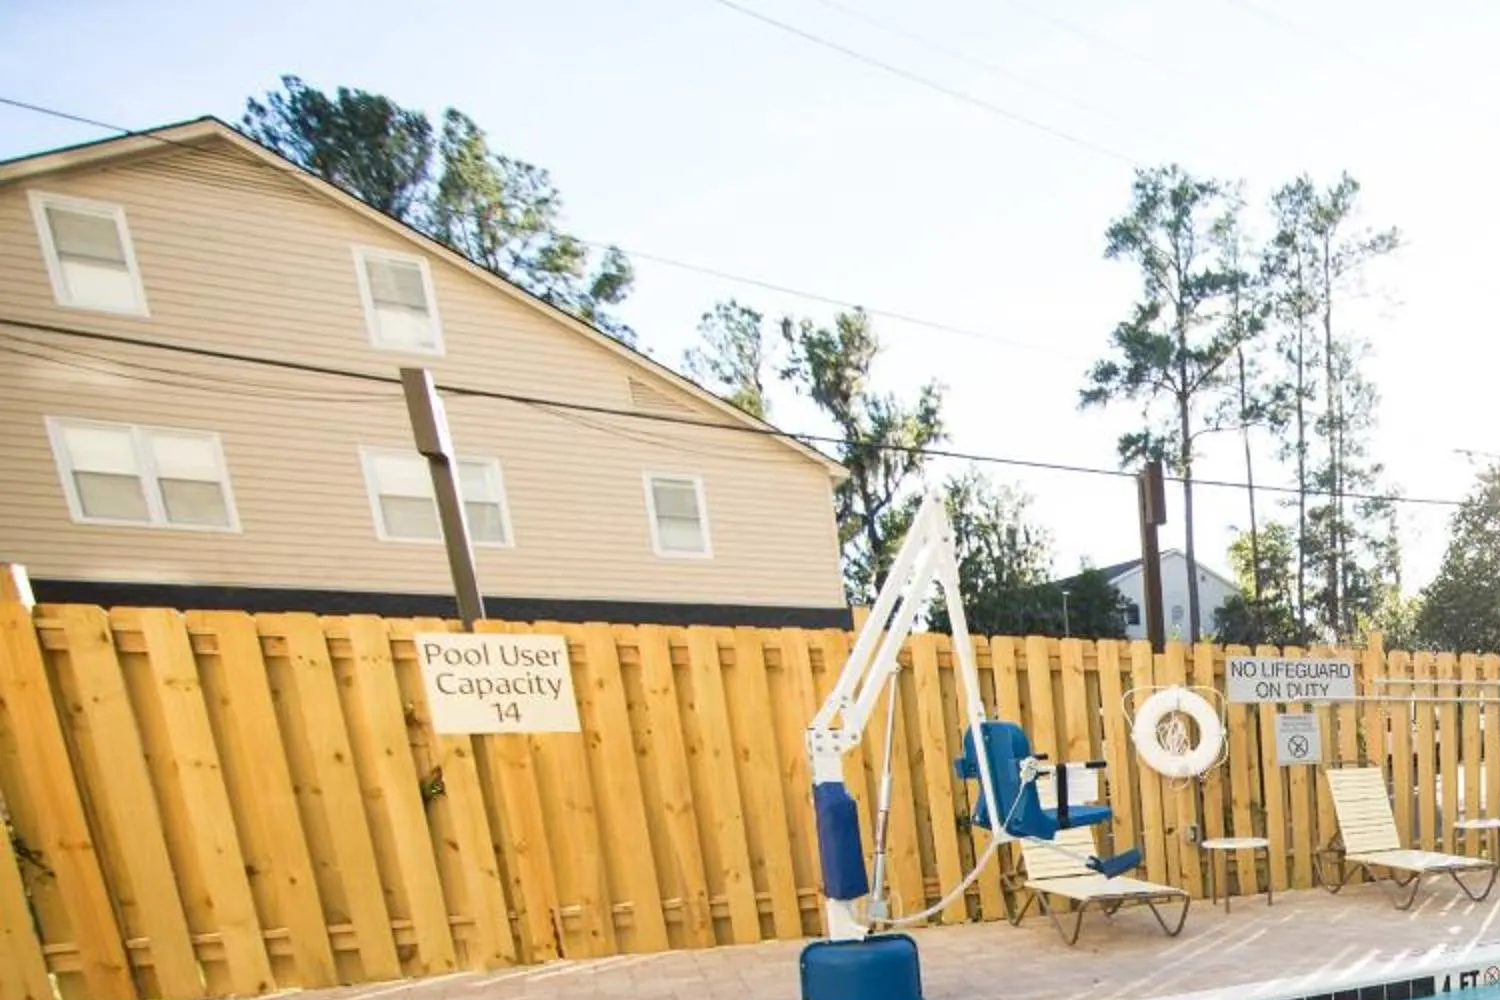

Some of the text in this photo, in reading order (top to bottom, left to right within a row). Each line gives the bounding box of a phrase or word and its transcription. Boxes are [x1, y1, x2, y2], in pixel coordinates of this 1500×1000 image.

[423, 643, 562, 667] Pool User
[1230, 660, 1351, 680] NO LIFEGUARD
[435, 671, 563, 700] Capacity
[1255, 681, 1329, 699] ON DUTY
[491, 701, 522, 724] 14
[1459, 970, 1480, 990] FT
